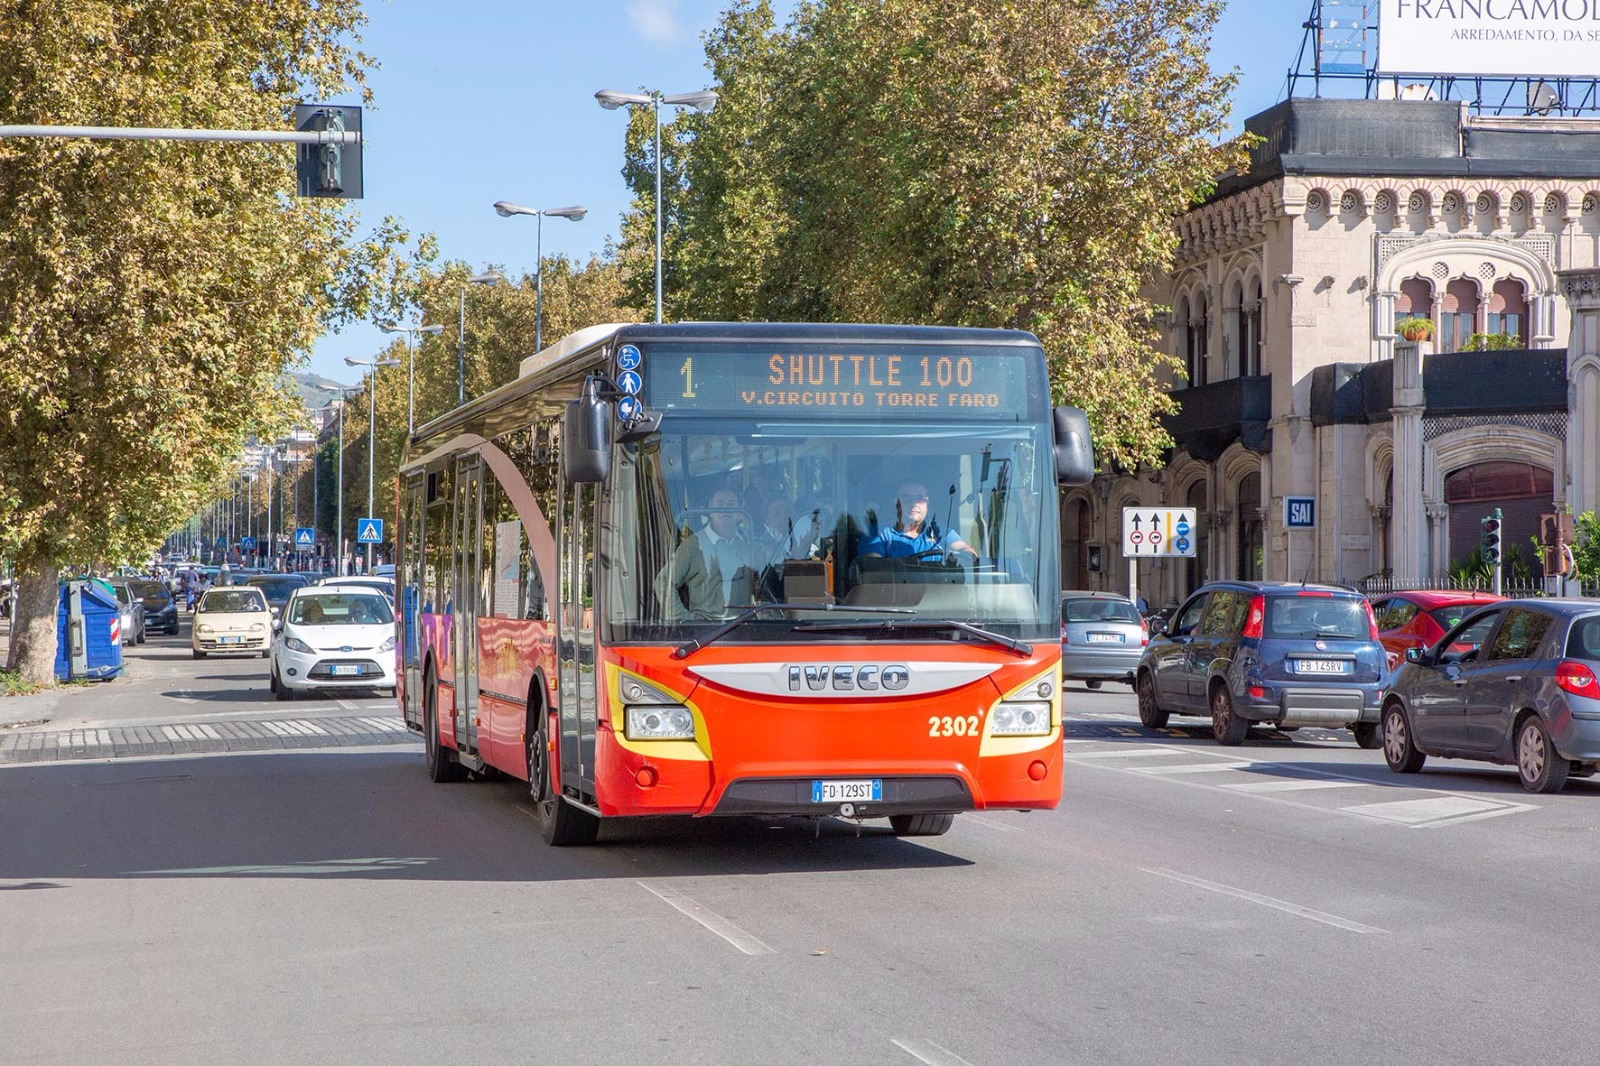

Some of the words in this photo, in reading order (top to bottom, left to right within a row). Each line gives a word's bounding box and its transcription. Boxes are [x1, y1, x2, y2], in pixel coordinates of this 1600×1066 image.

[1450, 28, 1558, 42] ARREDAMENTO,
[1563, 29, 1583, 41] DA
[680, 357, 696, 398] 1
[769, 354, 902, 386] SHUTTLE
[920, 356, 973, 387] 100
[875, 392, 939, 407] TORRE
[948, 393, 999, 408] FARO
[1291, 503, 1311, 523] SAI
[788, 664, 909, 691] IVECO
[928, 715, 979, 737] 2302
[822, 784, 836, 798] FD
[840, 783, 872, 798] 129ST
